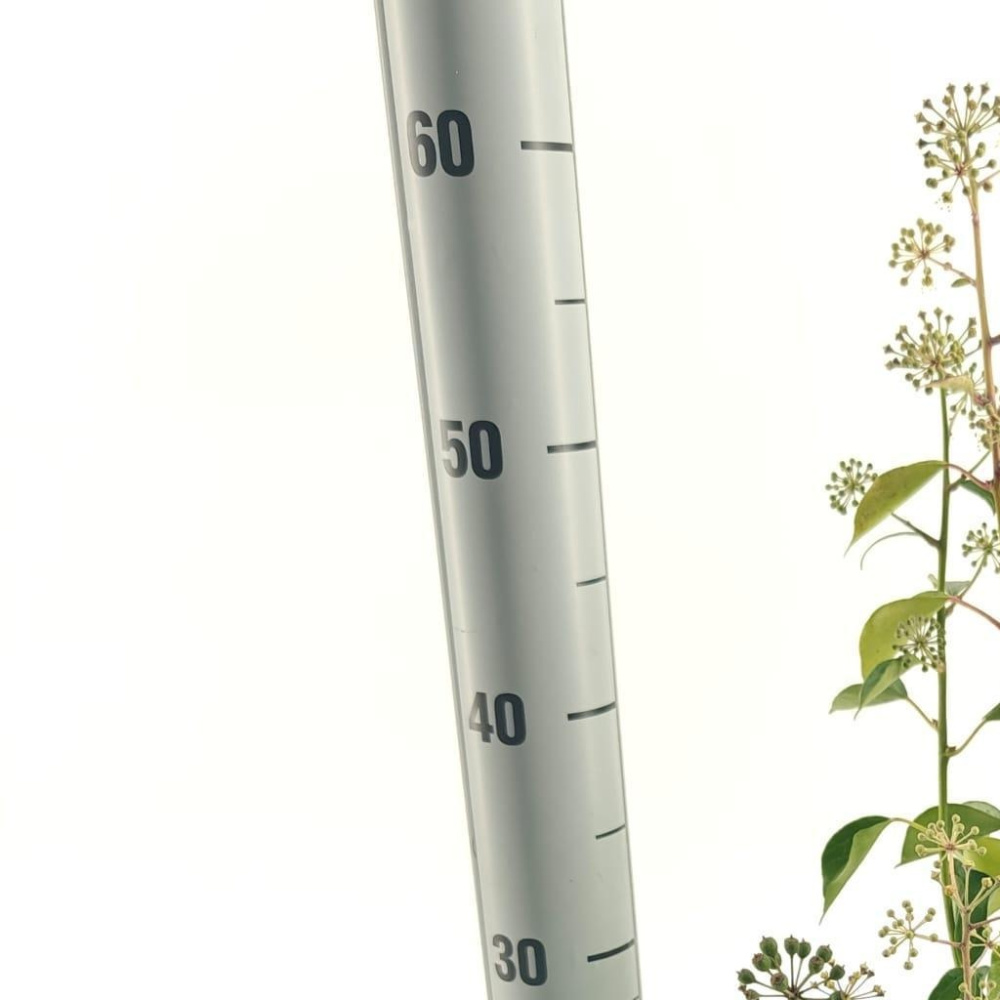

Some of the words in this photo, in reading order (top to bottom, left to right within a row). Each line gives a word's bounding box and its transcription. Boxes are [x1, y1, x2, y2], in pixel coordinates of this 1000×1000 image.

[406, 109, 475, 178] 60
[440, 419, 504, 481] 50
[468, 692, 527, 747] 40
[491, 934, 547, 987] 30
